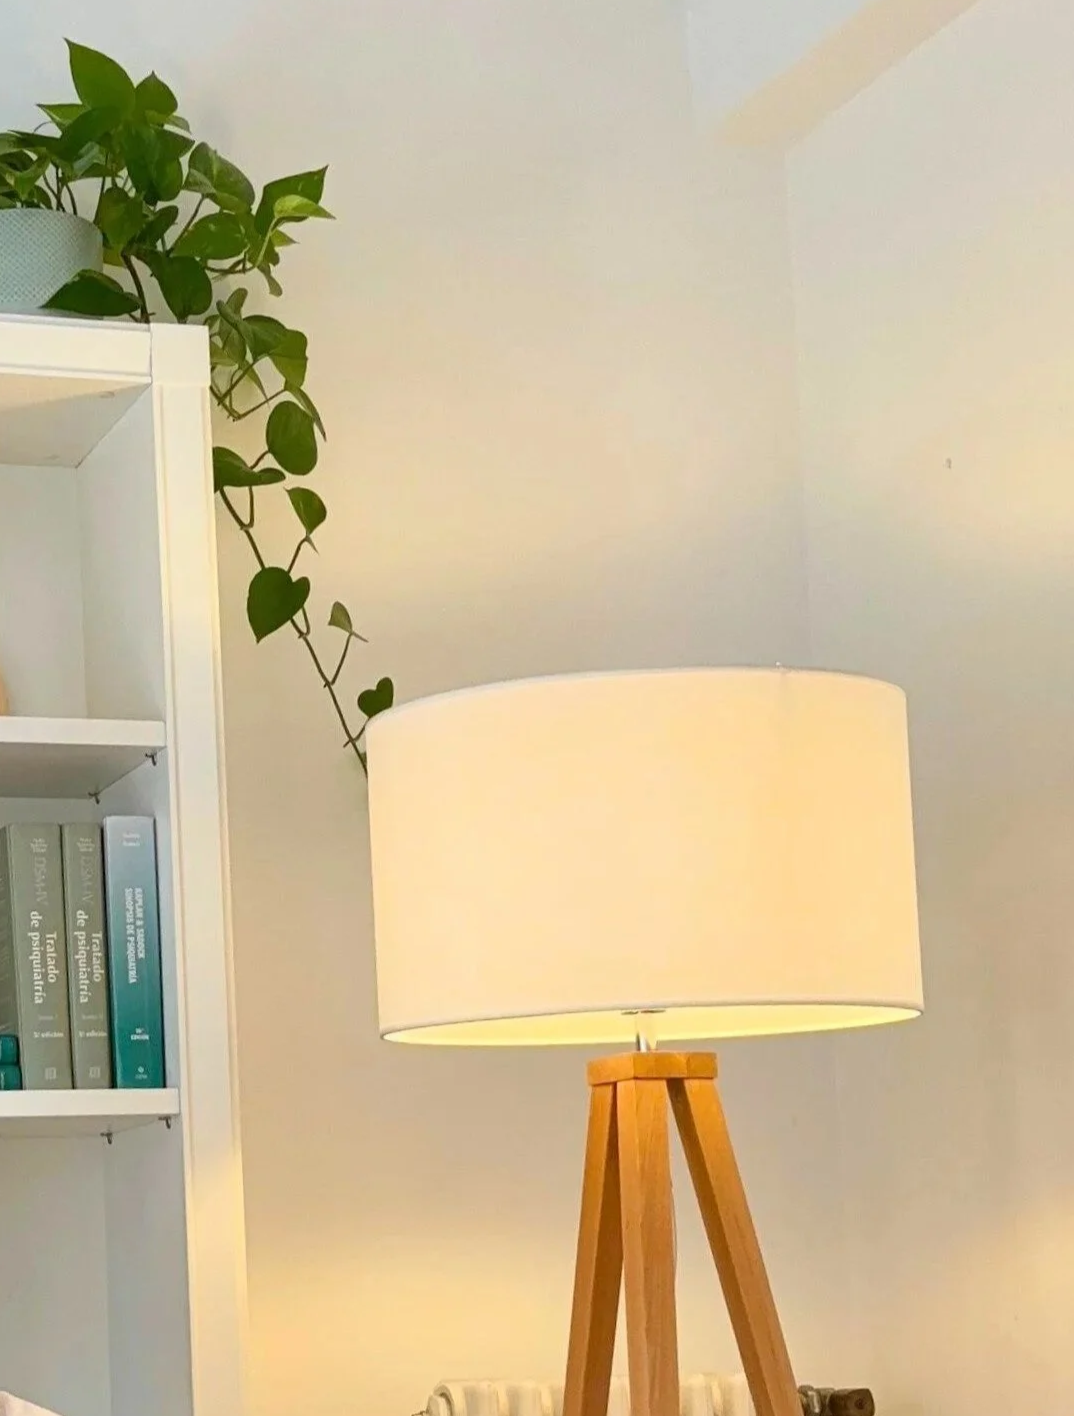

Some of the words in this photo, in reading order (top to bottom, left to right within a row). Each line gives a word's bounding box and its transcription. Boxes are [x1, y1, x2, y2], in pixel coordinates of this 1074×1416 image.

[30, 911, 42, 927] de
[77, 910, 89, 927] de
[137, 928, 145, 959] SADOCK
[28, 932, 46, 1004] psiquiatría
[46, 931, 59, 983] Tratado
[75, 931, 92, 1003] psiquiatría
[92, 931, 104, 983] Tratado
